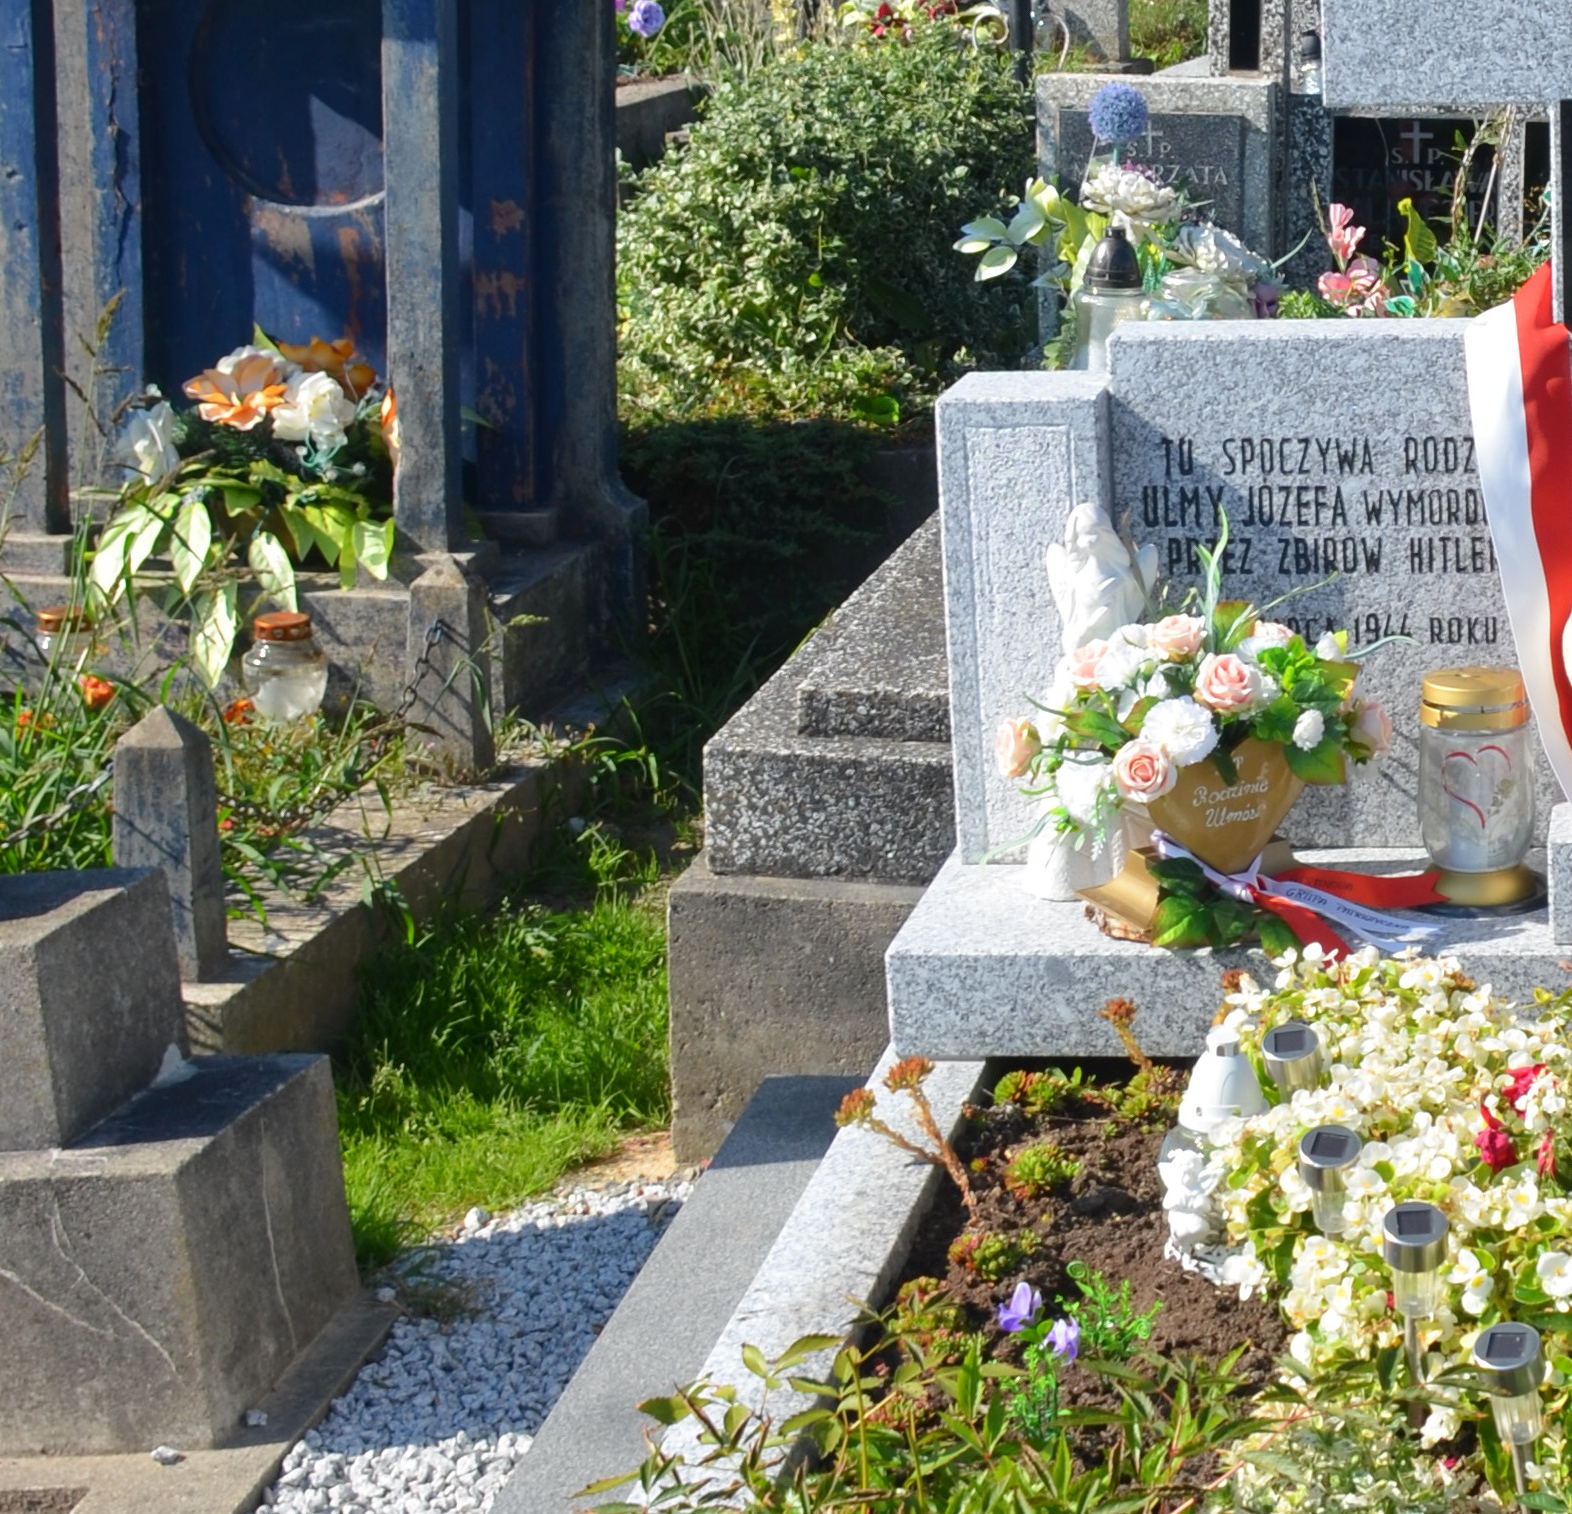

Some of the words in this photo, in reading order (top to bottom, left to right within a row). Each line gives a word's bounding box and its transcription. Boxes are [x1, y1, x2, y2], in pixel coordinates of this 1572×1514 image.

[1073, 162, 1229, 186] MRZATA
[1161, 436, 1195, 478] TU
[1221, 436, 1375, 476] SPOCZYWA
[1403, 435, 1478, 477] RODZ
[1142, 484, 1226, 529] ULMY
[1362, 488, 1489, 527] WYMORD
[1353, 612, 1413, 646] 1944
[1428, 616, 1499, 646] ROKU
